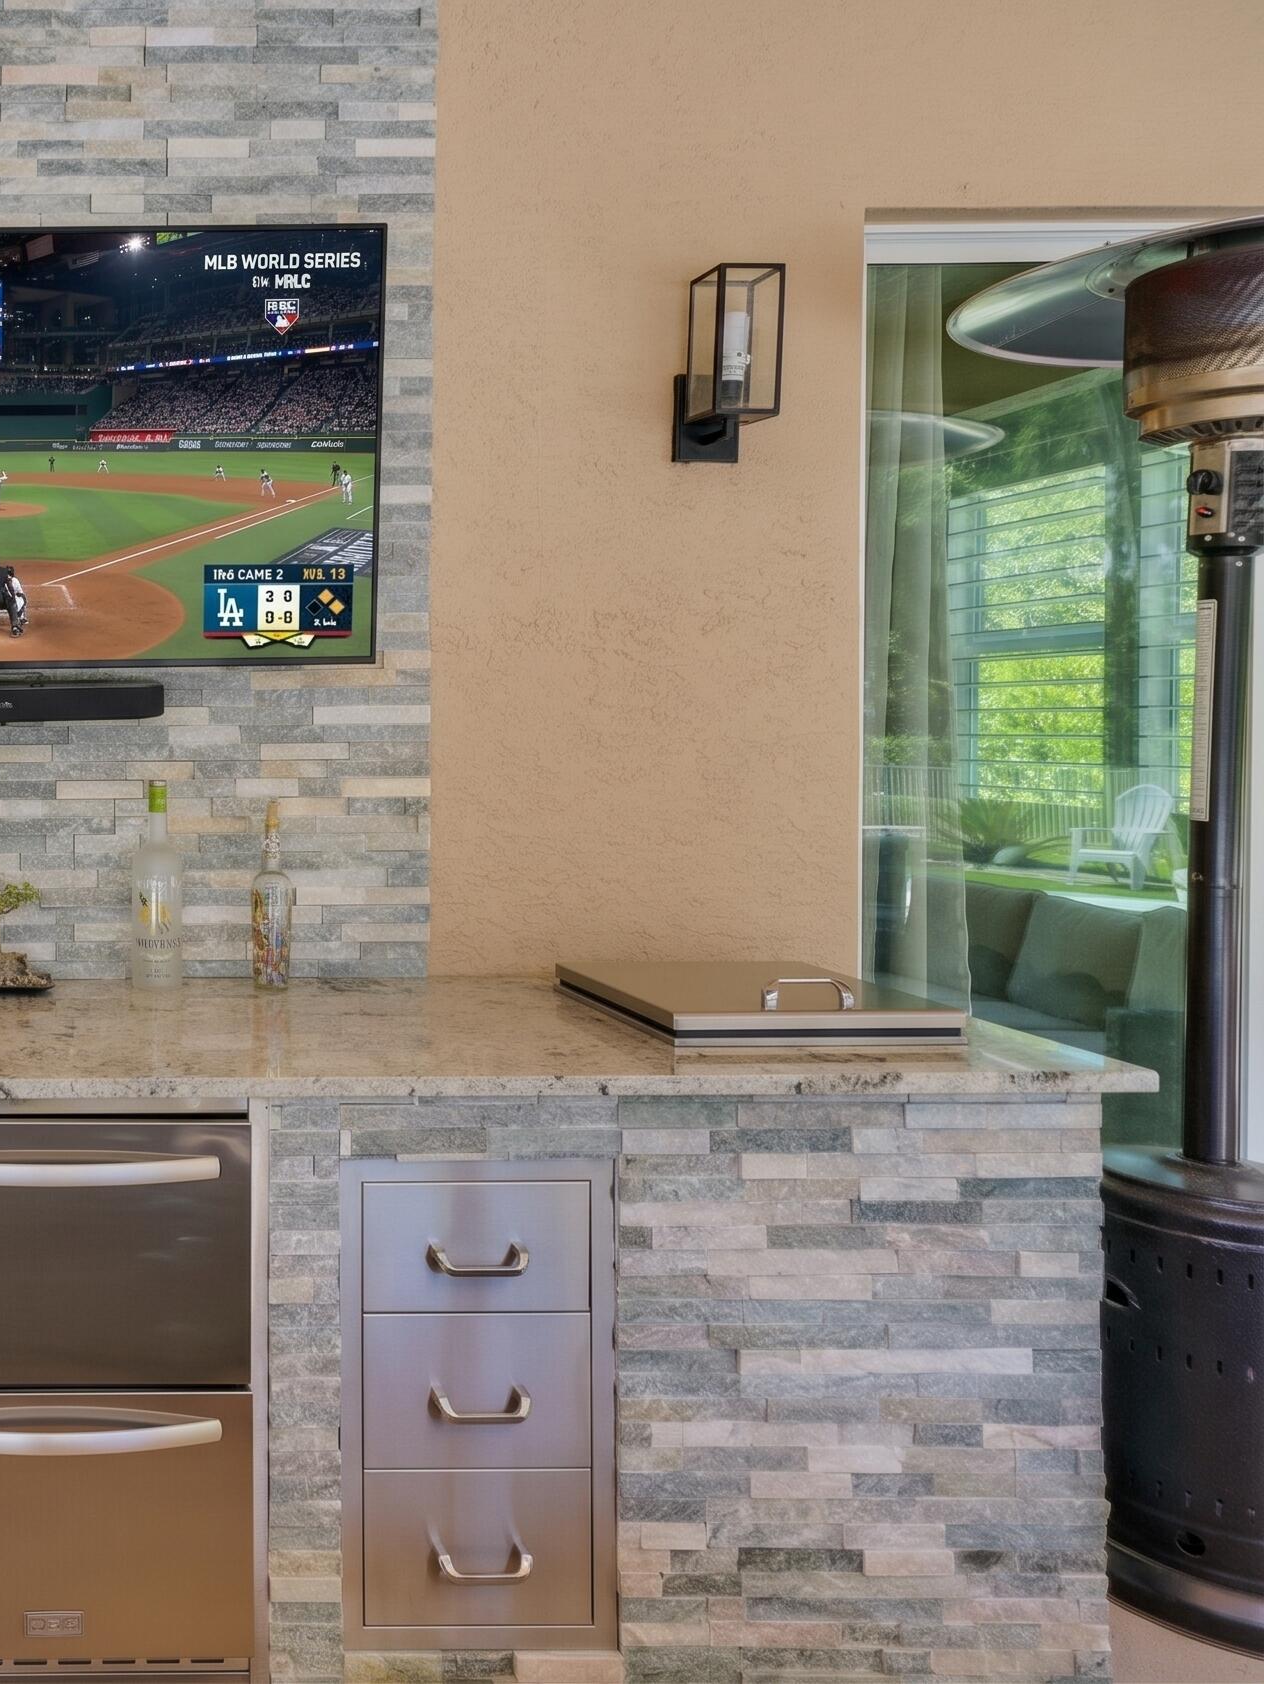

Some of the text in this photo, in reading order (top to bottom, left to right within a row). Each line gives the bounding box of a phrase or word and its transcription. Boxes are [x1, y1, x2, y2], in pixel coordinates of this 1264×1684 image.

[204, 252, 361, 270] MLB WORLD SERIES
[276, 569, 284, 580] 2
[330, 568, 346, 580] 13
[217, 588, 244, 627] LA
